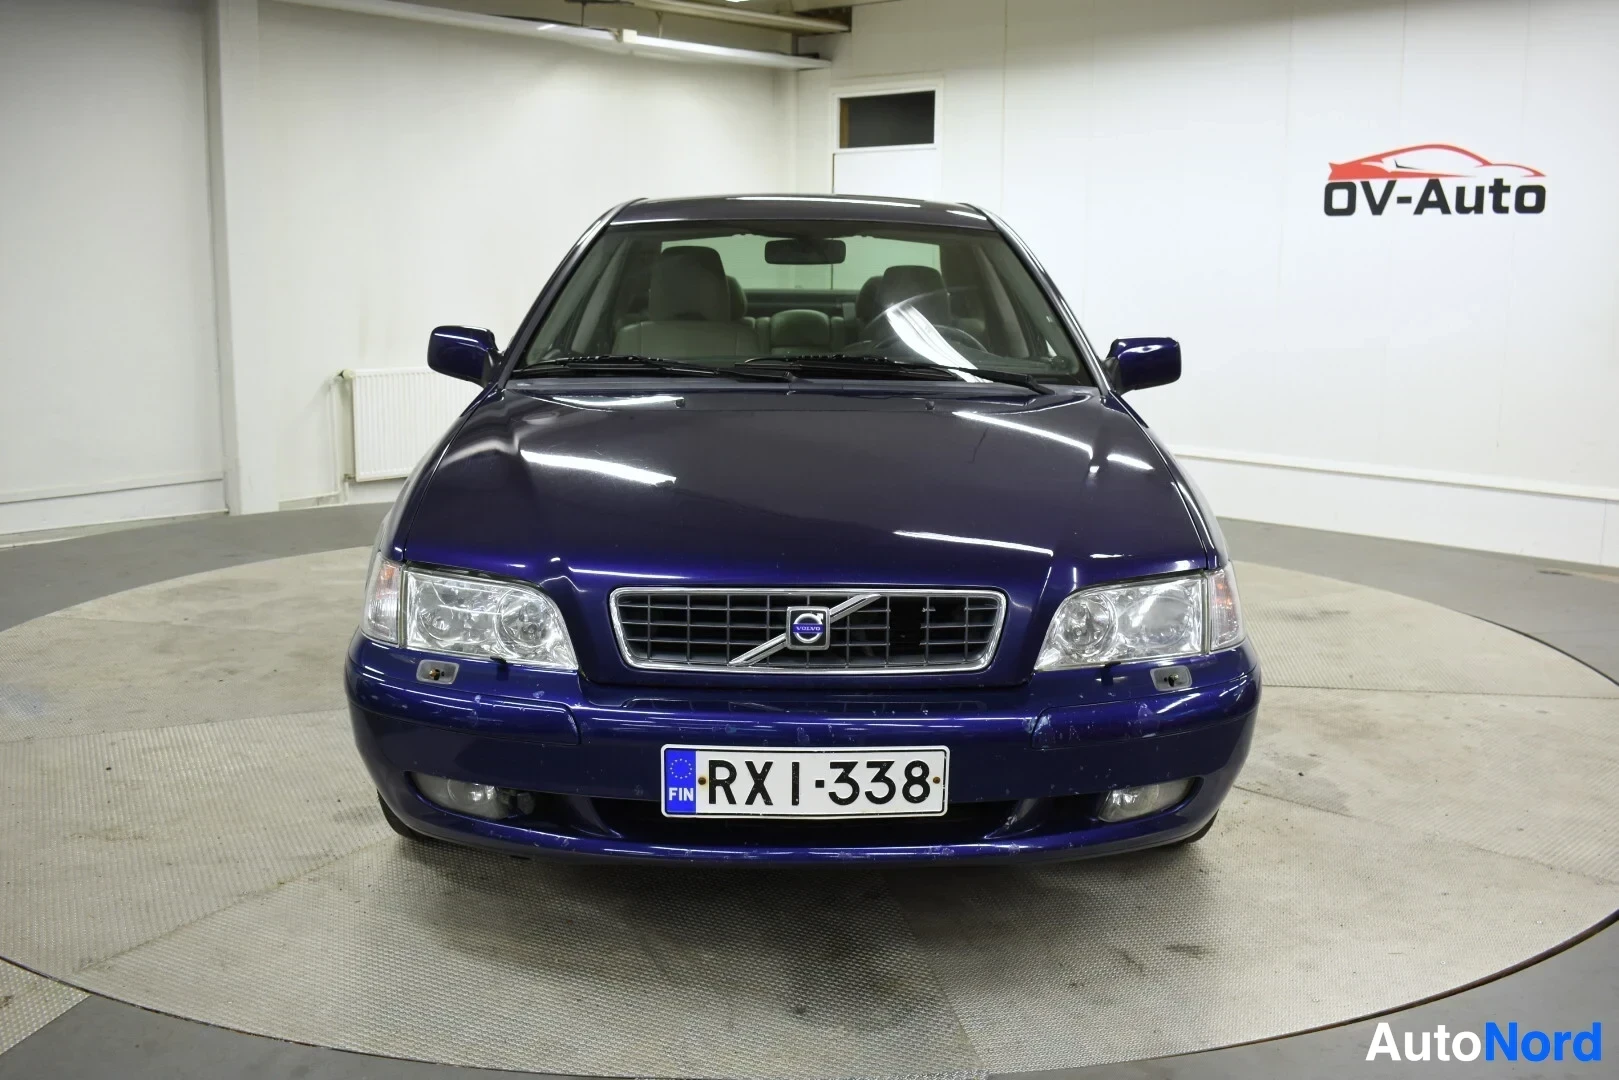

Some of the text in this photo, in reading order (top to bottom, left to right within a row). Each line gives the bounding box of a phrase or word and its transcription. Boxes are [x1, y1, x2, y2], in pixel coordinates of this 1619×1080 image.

[1324, 178, 1546, 216] OV-Auto
[668, 787, 694, 802] FIN
[708, 759, 931, 806] RXI-338
